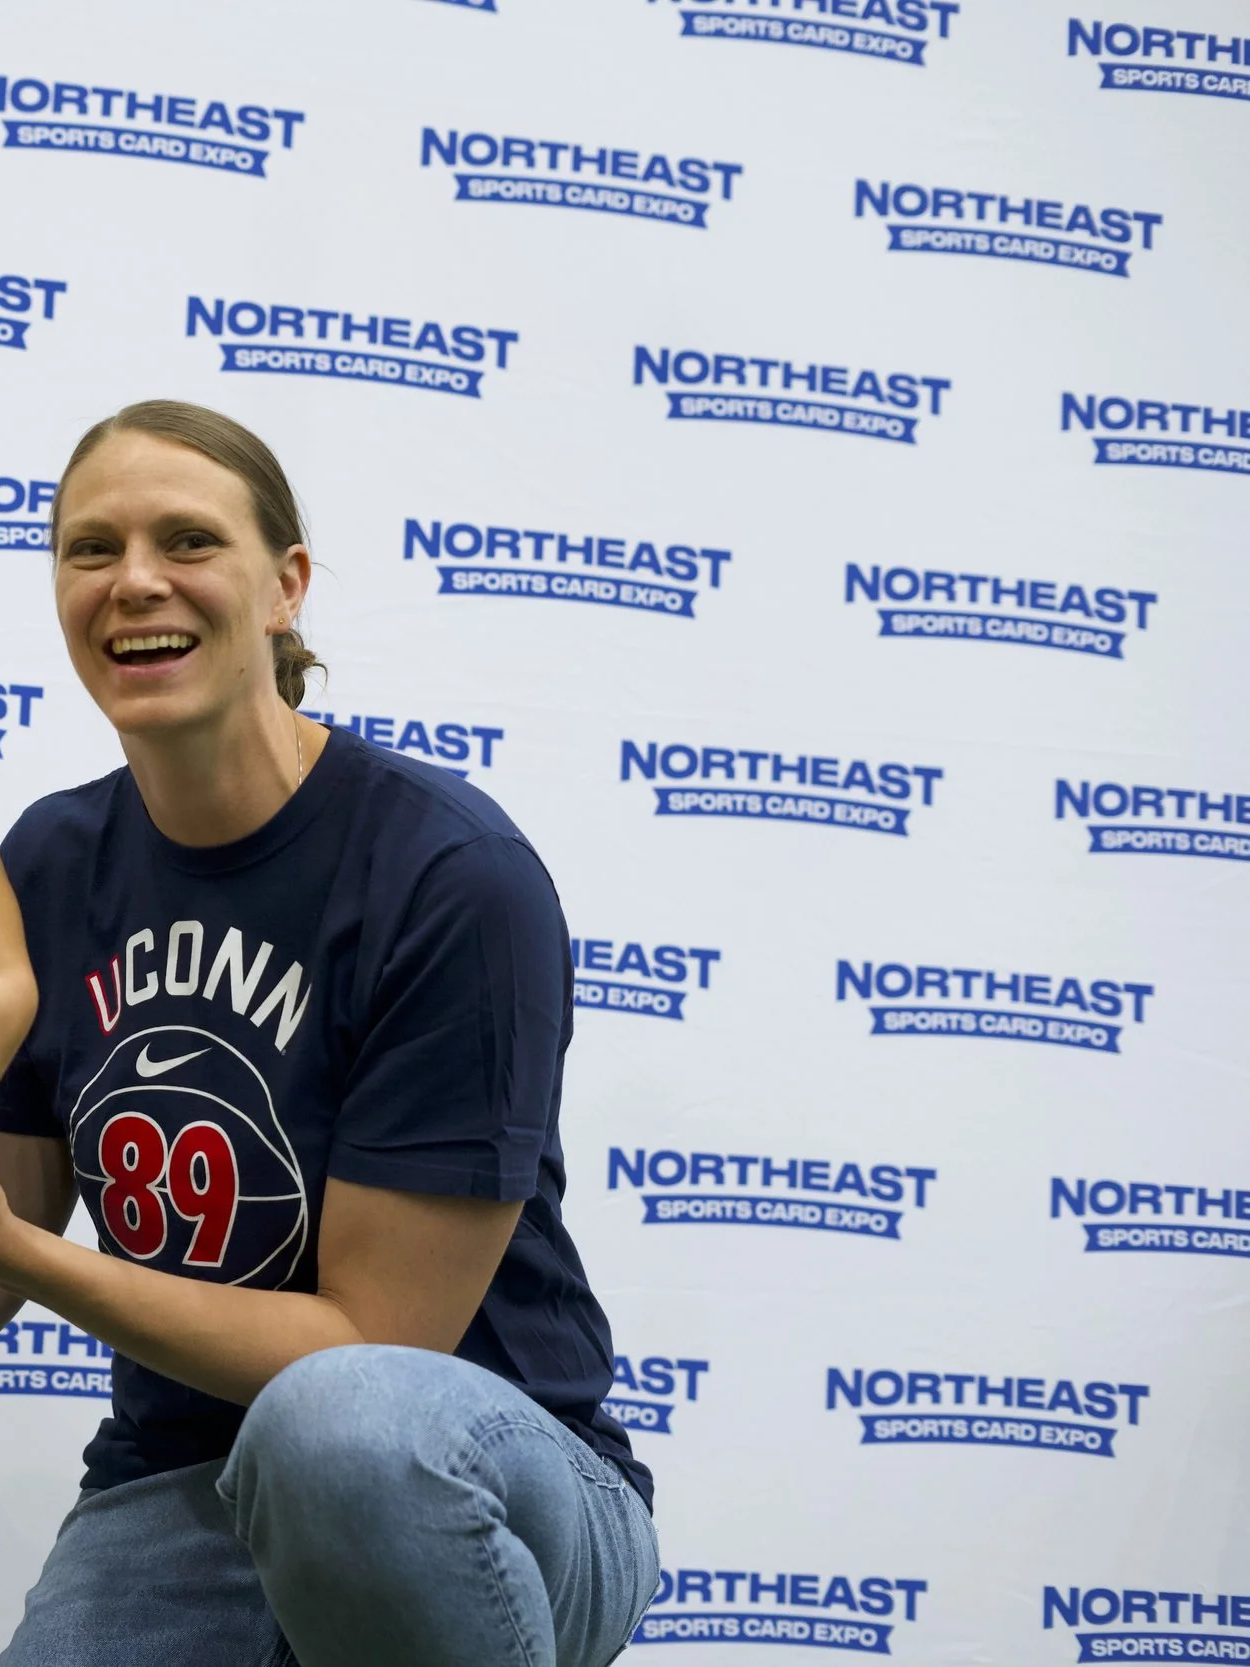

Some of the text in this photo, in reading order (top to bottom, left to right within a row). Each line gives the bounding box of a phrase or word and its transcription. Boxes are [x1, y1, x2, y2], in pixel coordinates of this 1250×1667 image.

[694, 16, 785, 38] SPORTS
[787, 23, 850, 46] CARD
[852, 32, 912, 59] EXPO
[1067, 19, 1250, 66] NORTH
[1112, 68, 1250, 96] SPORTS CAR
[18, 126, 254, 169] SPORTS CARD EXPO
[422, 128, 742, 200] NORTHEAST
[470, 179, 694, 222] SPORTS CARD EXPO
[855, 180, 1162, 249] NORTHEAST
[901, 230, 1118, 270] SPORTS CARD EXPO
[186, 296, 519, 368] NORTHEAST
[235, 350, 469, 390] SPORTS CARD EXPO
[634, 345, 951, 415] NORTHEAST
[681, 398, 904, 436] SPORTS CARD EXPO
[1062, 393, 1250, 440] NORTH
[1105, 442, 1195, 464] SPORTS
[403, 519, 732, 588] NORTHEAST
[453, 572, 683, 610] SPORTS CARD EXPO
[846, 563, 1157, 629] NORTHEAST
[892, 615, 1112, 651] SPORTS CARD EXPO
[621, 740, 943, 806] NORTHEAST
[669, 793, 895, 829] SPORTS CARD EXPO
[1101, 830, 1191, 851] SPORTS
[85, 920, 311, 1052] UCONN
[607, 987, 671, 1013] EXPO
[837, 960, 1154, 1022] NORTHEAST
[884, 1012, 1107, 1046] SPORTS CARD EXPO
[98, 1111, 239, 1268] 89
[608, 1147, 937, 1208] NORTHEAST
[1051, 1177, 1250, 1220] NORTHE
[657, 1200, 888, 1232] SPORTS CARD EXPO
[1097, 1229, 1188, 1248] SPORTS
[602, 1403, 658, 1427] XPO
[826, 1368, 1149, 1424] NORTHEAST
[875, 1420, 1102, 1449] SPORTS CARD EXPO
[1043, 1586, 1250, 1629] NORTHE
[643, 1617, 877, 1647] SPORTS CARD EXPO
[1091, 1638, 1184, 1657] SPORTS
